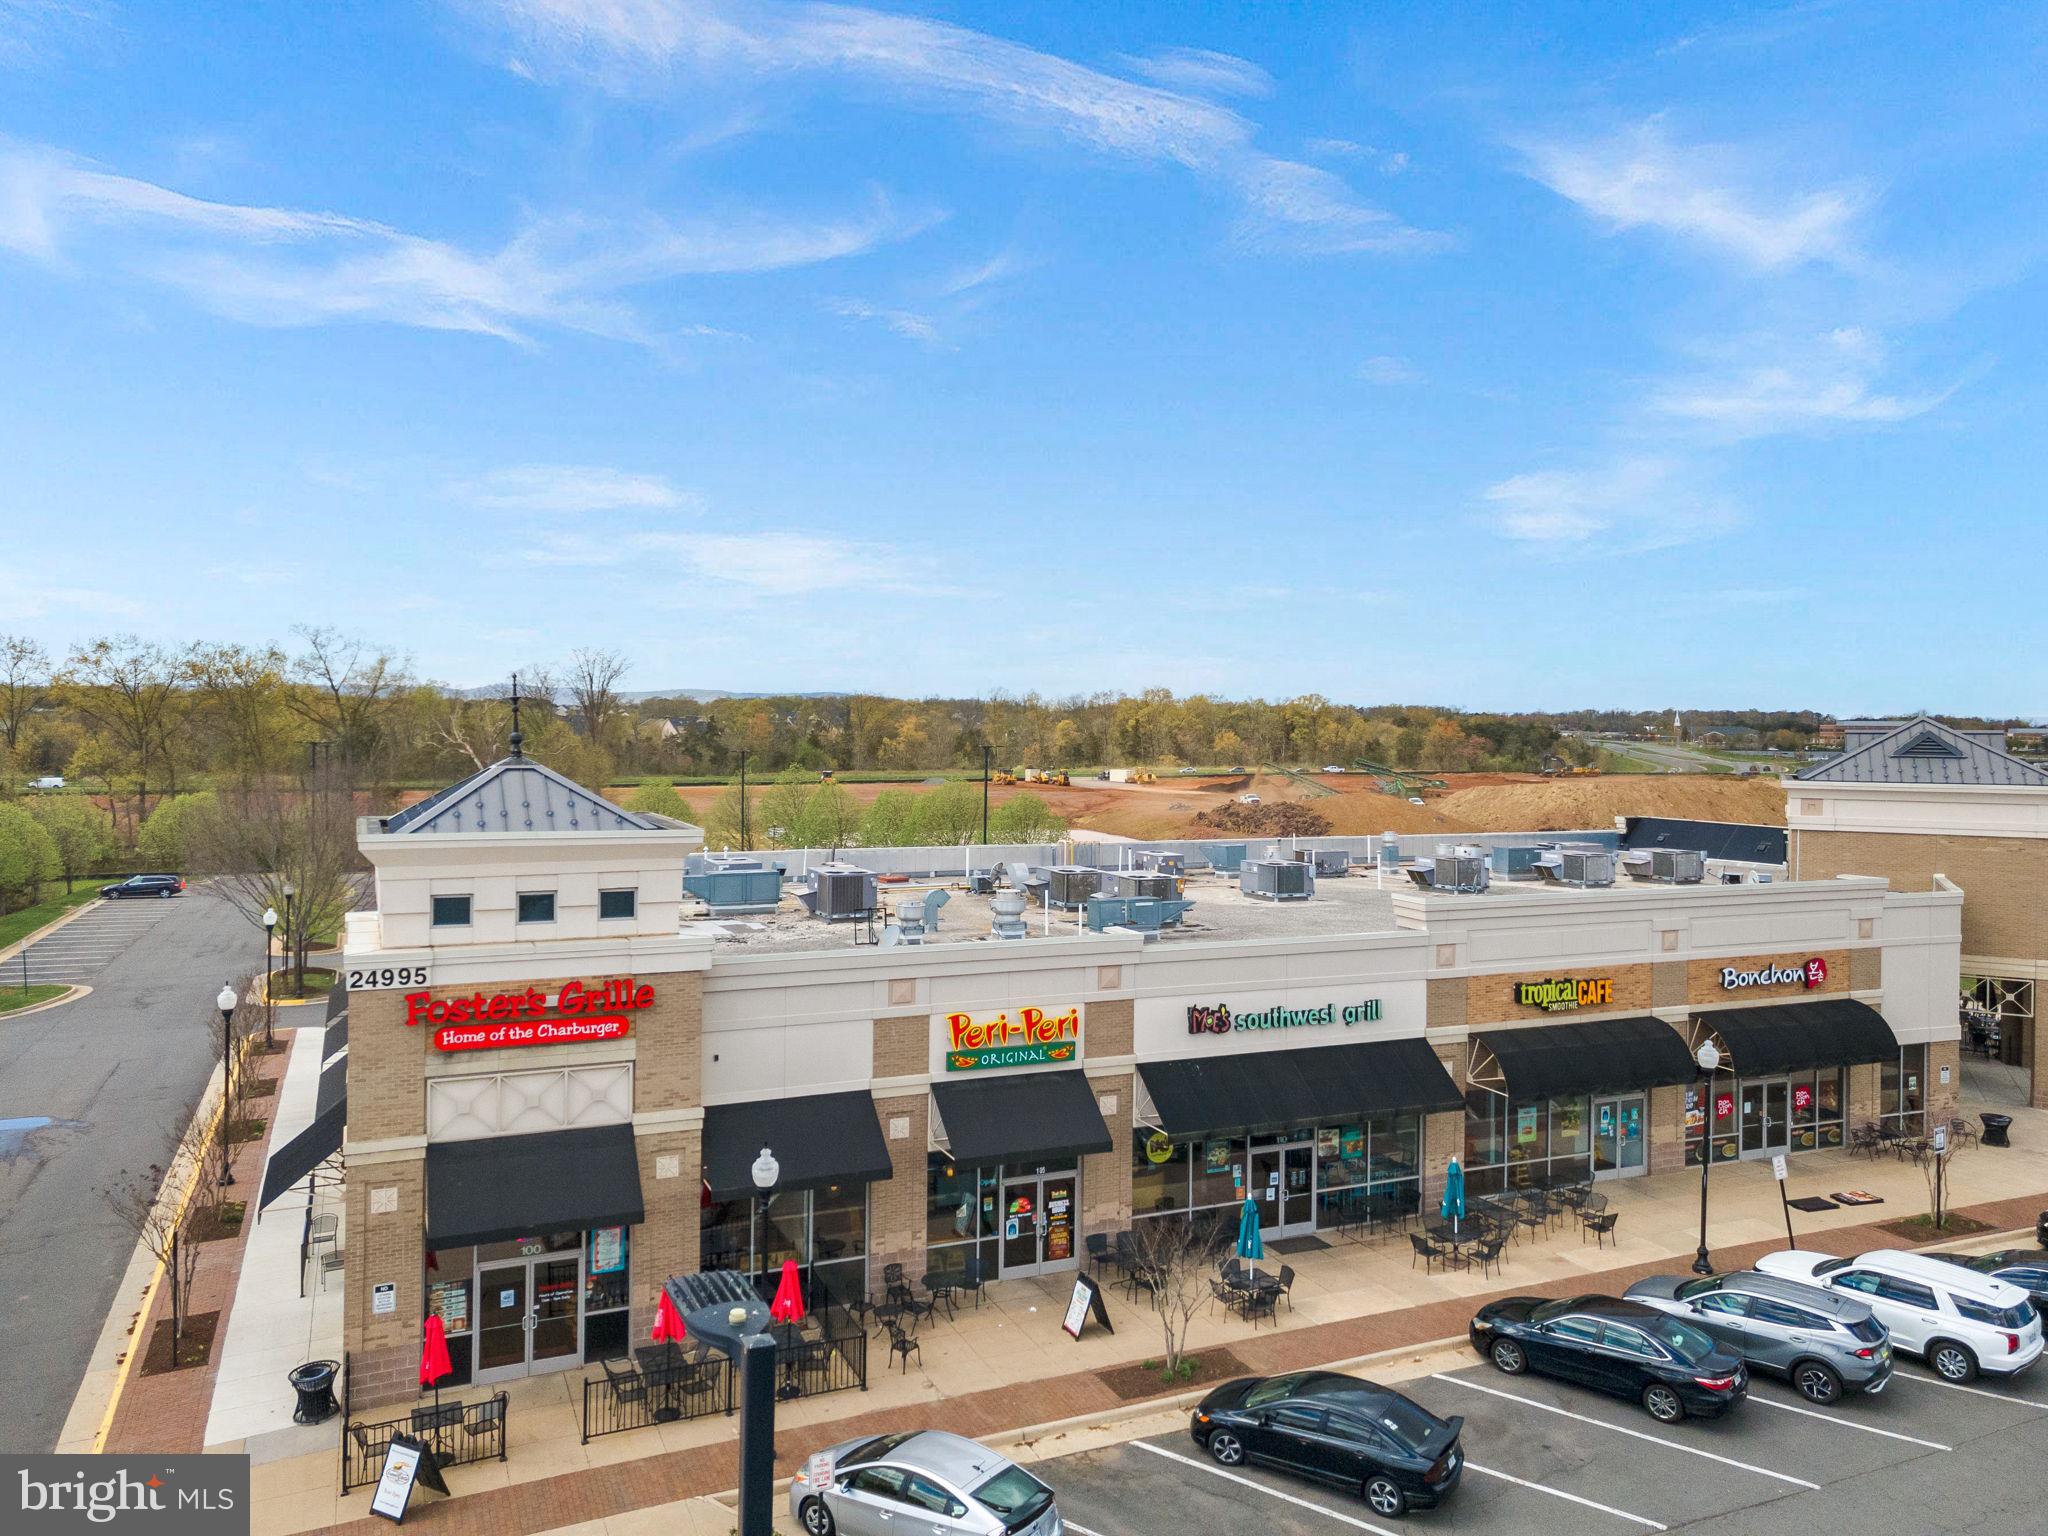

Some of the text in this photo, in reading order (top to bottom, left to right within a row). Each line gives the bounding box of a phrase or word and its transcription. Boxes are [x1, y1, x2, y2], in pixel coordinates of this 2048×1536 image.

[350, 967, 427, 989] 24995
[1723, 963, 1805, 989] Bonchon
[404, 978, 655, 1026] Foster's Grille
[1520, 978, 1614, 1007] tropical CAFE
[1235, 1003, 1337, 1032] southwest
[1343, 998, 1382, 1026] grill
[1548, 1001, 1579, 1012] SMOOTHIE
[442, 1021, 620, 1046] Home of the Charburger
[945, 1007, 1079, 1052] Peri-Peri
[981, 1048, 1046, 1065] ORIGINAL
[520, 1244, 542, 1256] 100
